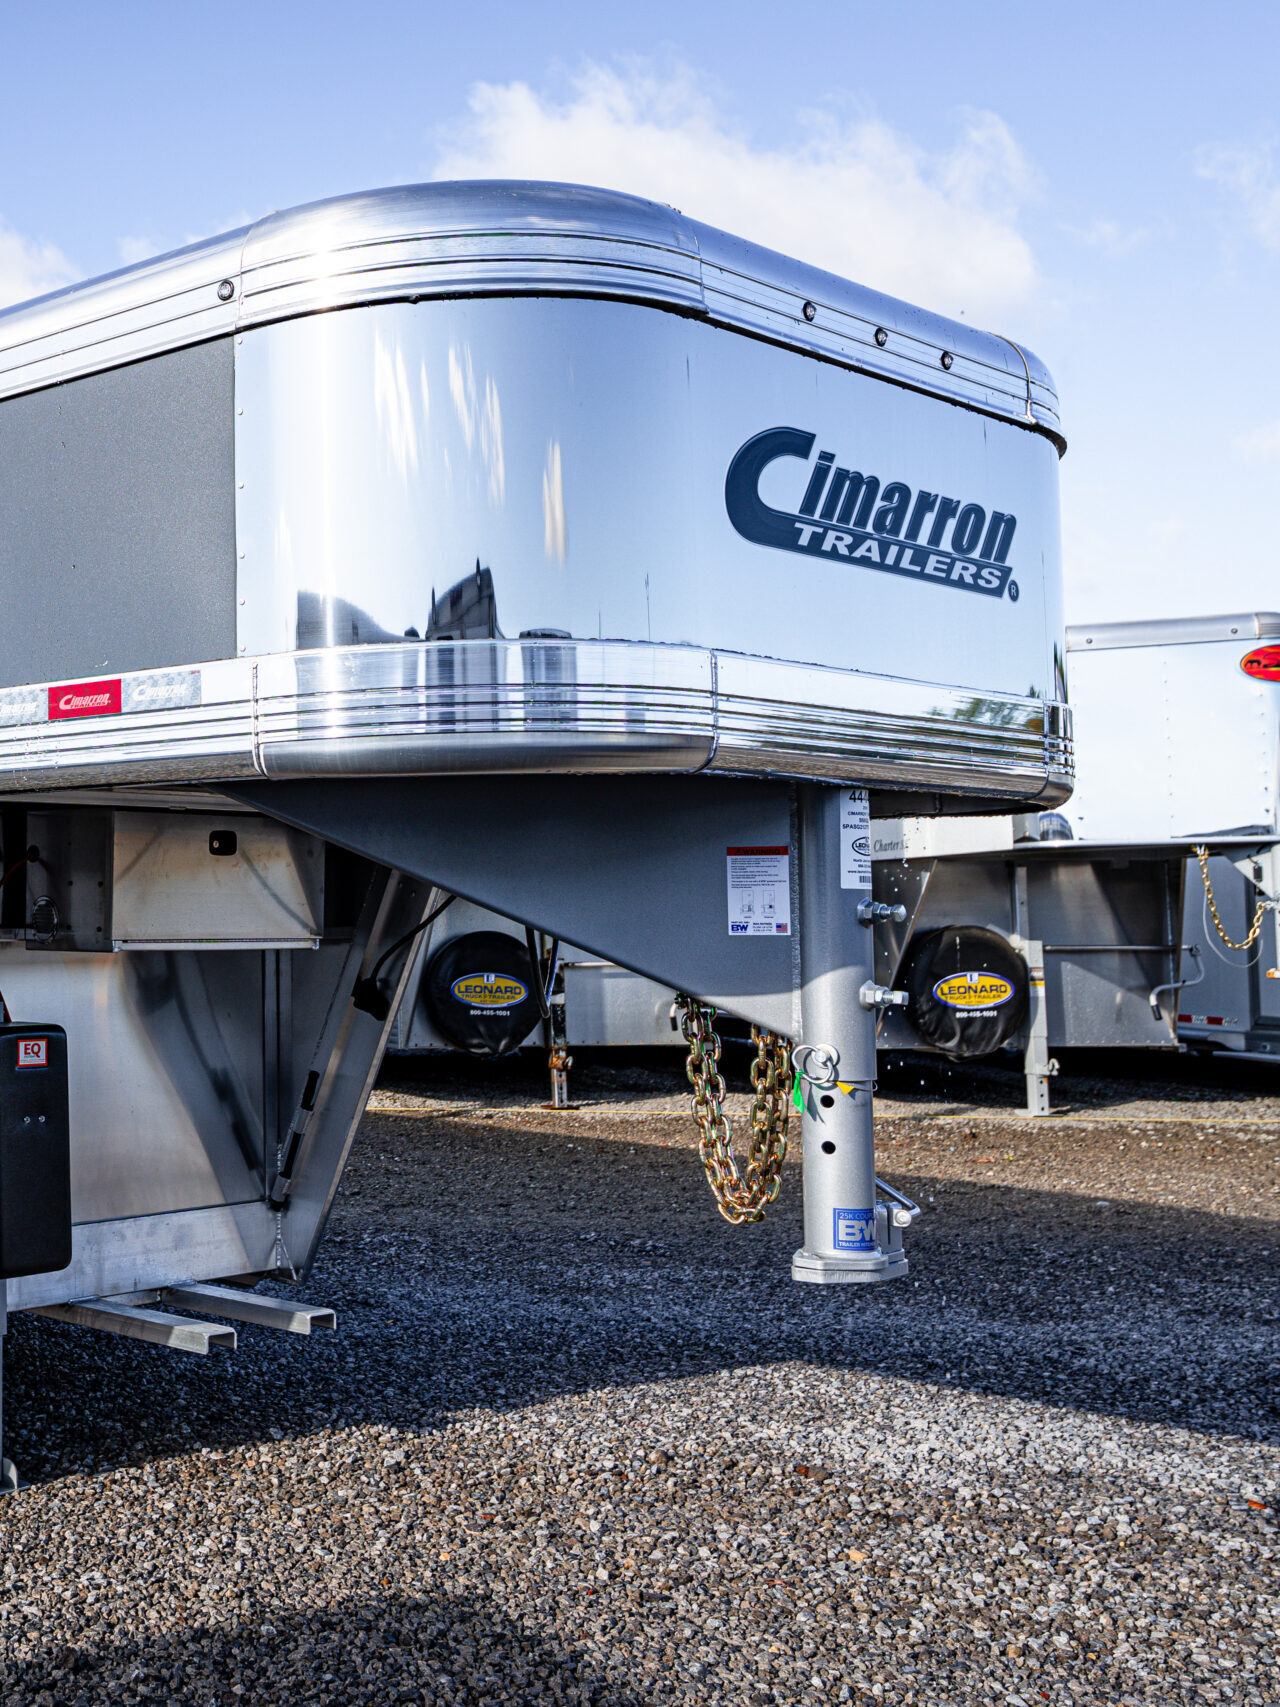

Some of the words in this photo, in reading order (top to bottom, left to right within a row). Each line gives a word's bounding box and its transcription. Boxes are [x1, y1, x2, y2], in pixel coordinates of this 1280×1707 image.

[724, 426, 1018, 565] Cimarron
[794, 522, 1003, 590] TRAILERS
[59, 693, 111, 711] Cimarron
[743, 848, 781, 856] WARNING
[874, 839, 899, 852] Charter
[458, 984, 522, 995] LEONARD
[940, 984, 1008, 996] LEONARD
[24, 1043, 41, 1058] EQ
